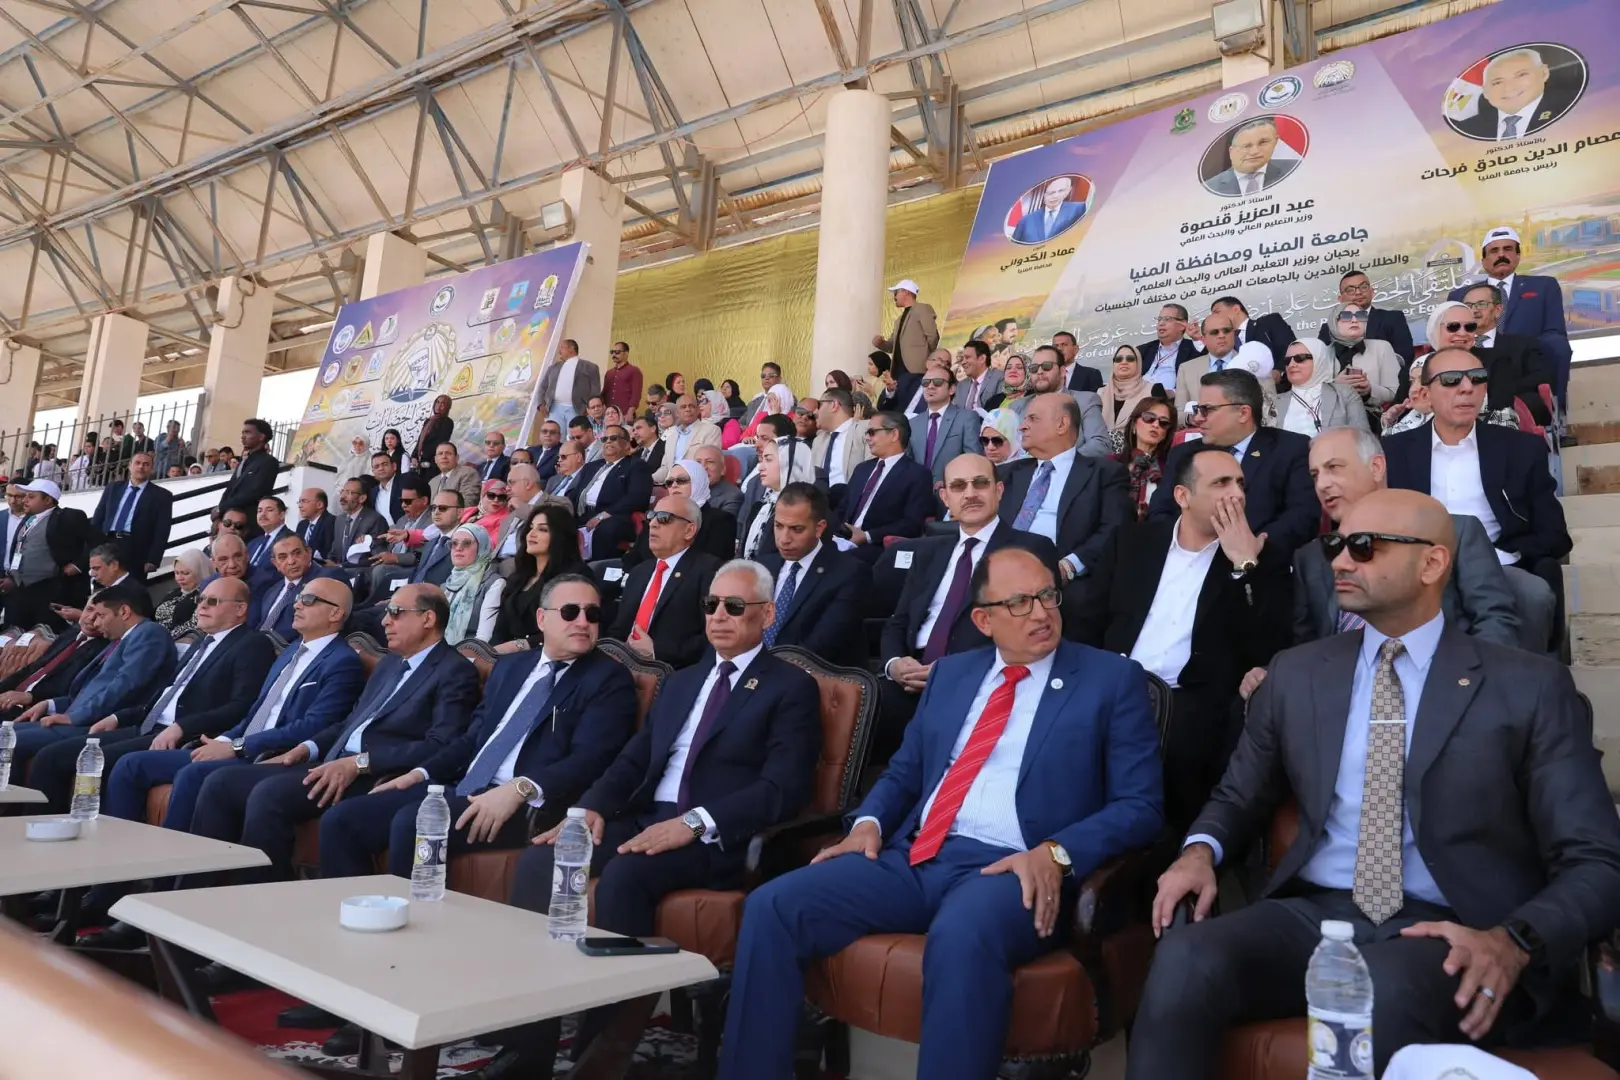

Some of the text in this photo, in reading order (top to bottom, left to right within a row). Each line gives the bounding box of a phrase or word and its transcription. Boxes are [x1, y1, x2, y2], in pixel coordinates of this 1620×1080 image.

[1420, 131, 1620, 181] عصام الدين صادق فرحات
[1484, 143, 1514, 156] الدكتور
[1478, 161, 1558, 182] رئيس جامعة المنيا
[1219, 200, 1246, 212] الدكتور
[1180, 198, 1315, 235] عبد العزيز قنصوة
[1179, 213, 1313, 247] وزير التعليم العالي والبحث العلمي
[1050, 247, 1075, 258] عماد
[1129, 227, 1369, 284] جامعة المنيا ومحافظة المنيا
[1324, 248, 1360, 262] يرحبان
[1000, 251, 1047, 272] الكدواني
[1251, 257, 1289, 273] التعليم
[1292, 255, 1320, 268] بوزير
[1359, 254, 1410, 271] والطلاب
[1175, 273, 1211, 286] والبحث
[1303, 262, 1355, 281] الوافدين
[1135, 279, 1172, 296] العلمي
[1200, 279, 1242, 295] المصرية
[1245, 272, 1300, 289] بالجامعات
[1142, 292, 1177, 305] مختلف
[1179, 290, 1197, 300] من
[1094, 298, 1140, 313] الجنسيات
[1296, 320, 1317, 331] the
